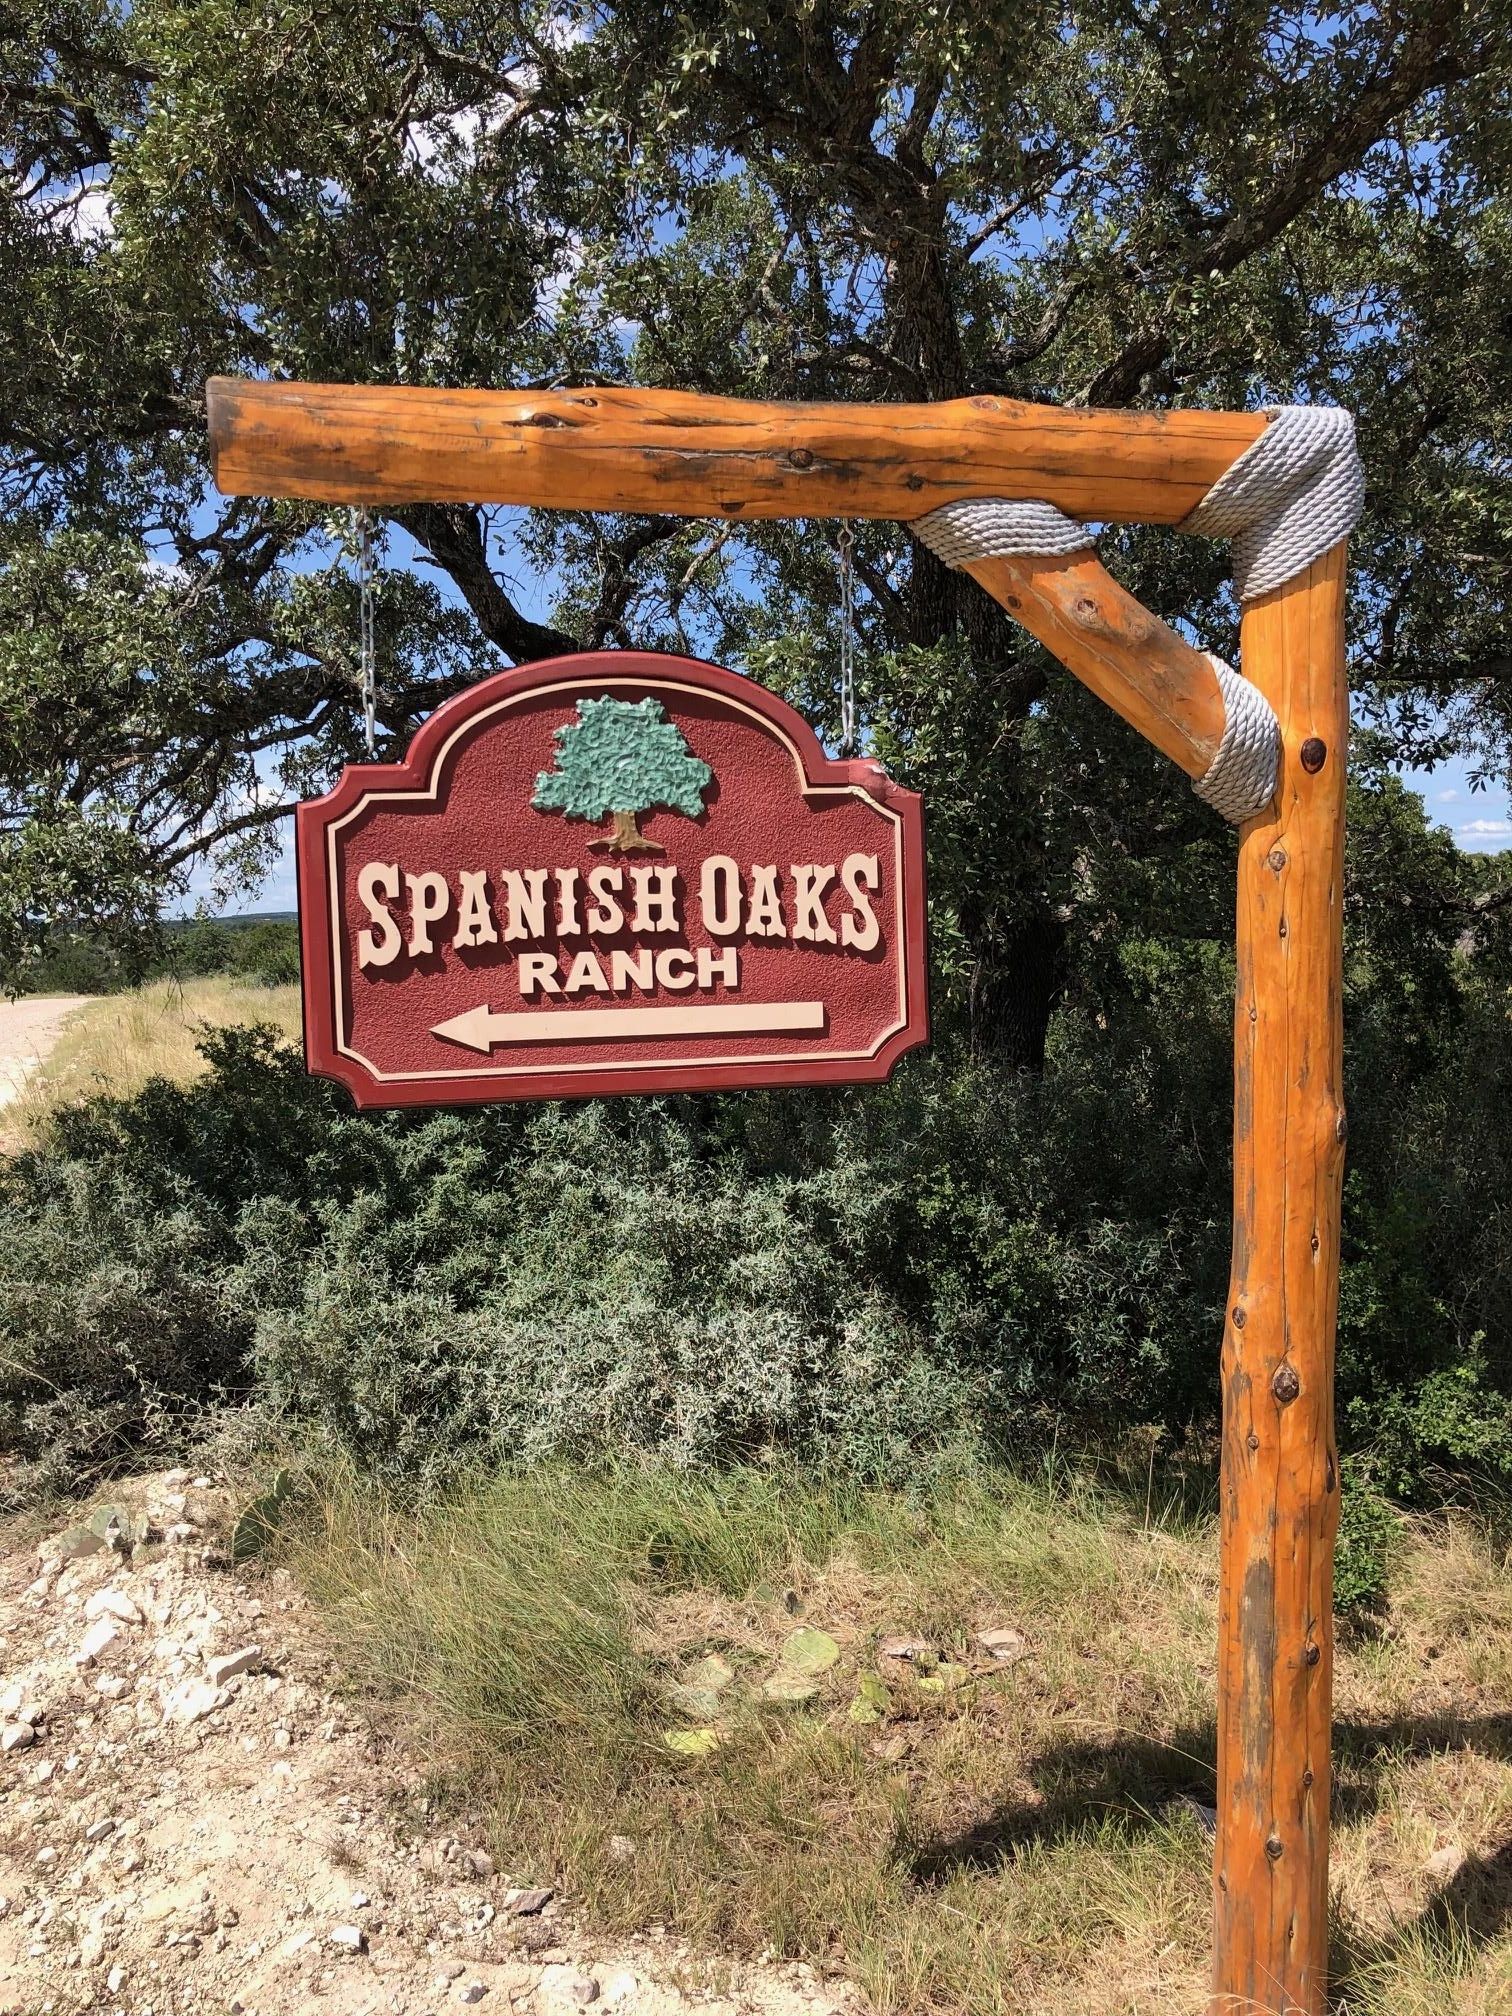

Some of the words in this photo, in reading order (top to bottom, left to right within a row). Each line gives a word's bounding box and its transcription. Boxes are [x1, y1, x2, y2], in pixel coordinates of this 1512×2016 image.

[358, 861, 680, 970] SPANISH
[697, 853, 880, 952] OAKS
[518, 946, 739, 994] RANCH
